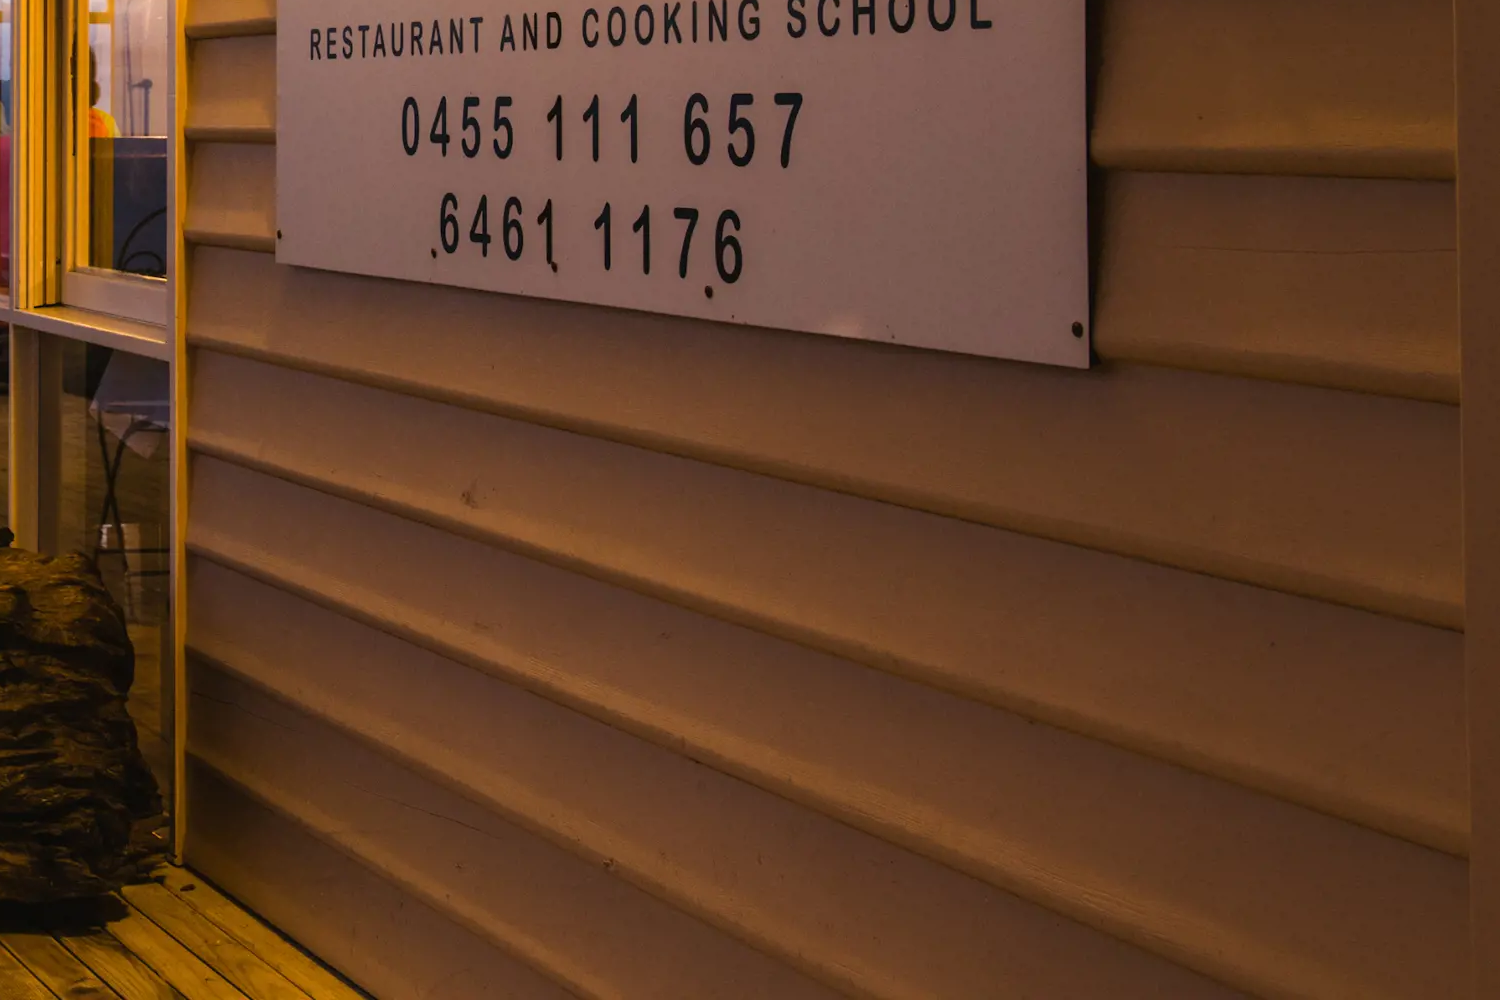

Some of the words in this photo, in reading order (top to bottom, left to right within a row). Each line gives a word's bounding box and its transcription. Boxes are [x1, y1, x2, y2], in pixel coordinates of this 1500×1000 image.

[310, 15, 484, 61] RESTAURANT
[499, 11, 563, 53] AND
[401, 95, 514, 160] 0455
[546, 93, 638, 164] 111
[683, 92, 804, 169] 657
[439, 192, 557, 260] 6461
[593, 201, 743, 285] 1176
